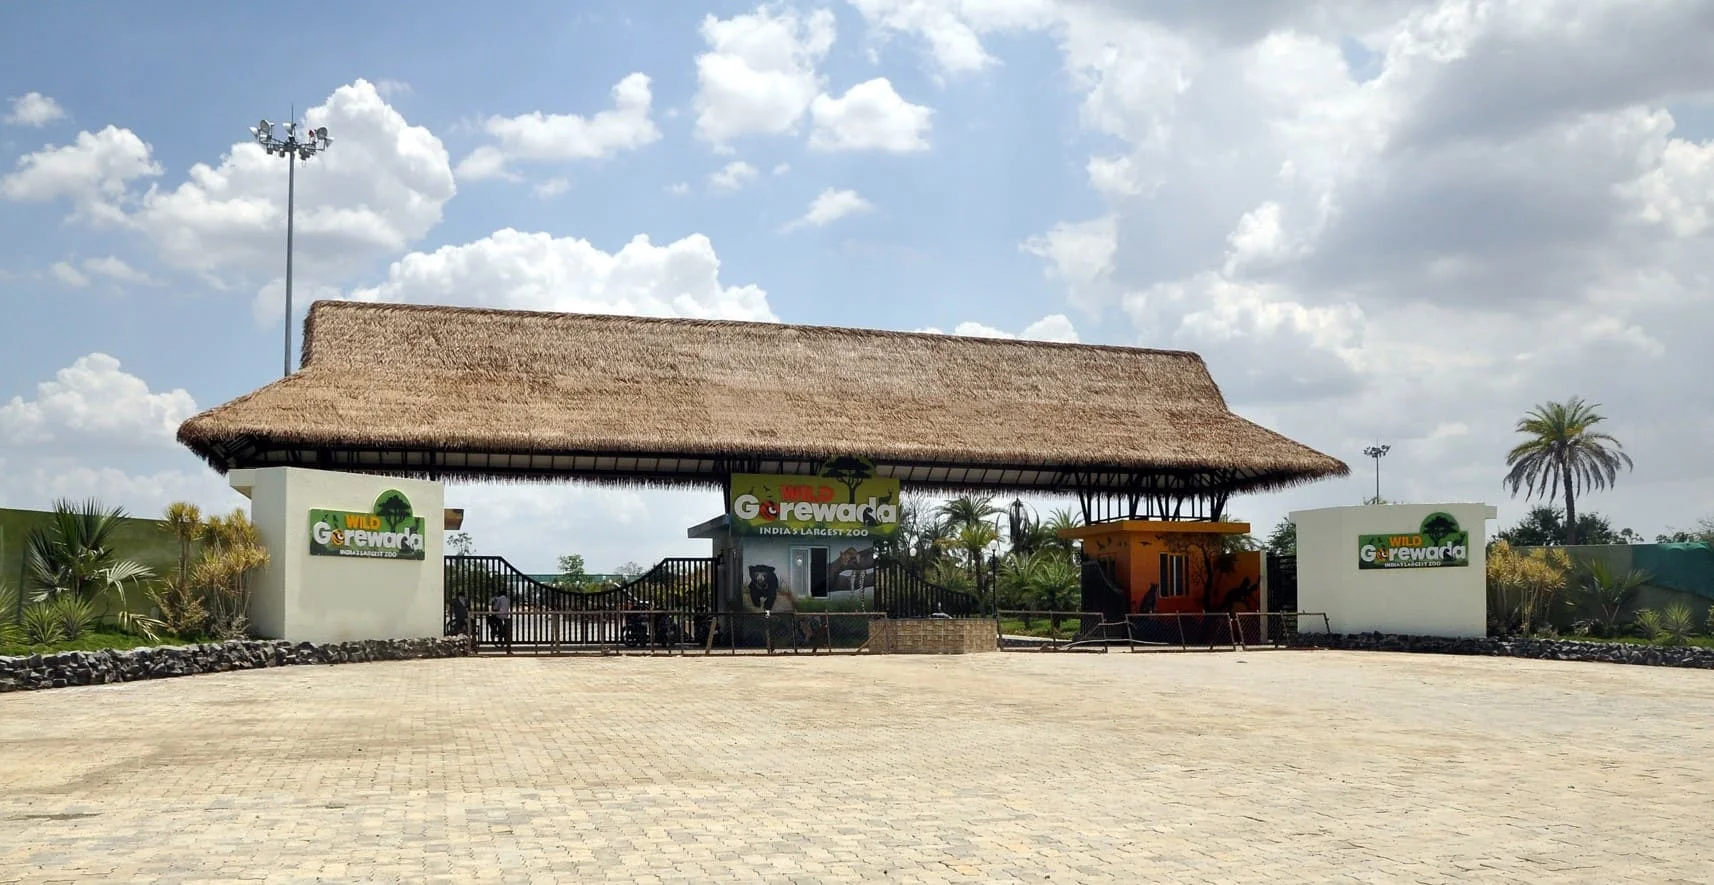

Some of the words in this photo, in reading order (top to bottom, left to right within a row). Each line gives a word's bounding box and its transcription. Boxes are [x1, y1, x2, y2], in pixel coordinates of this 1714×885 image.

[781, 484, 834, 503] WILD
[734, 495, 897, 523] Gorewada
[345, 514, 381, 529] WILD
[313, 521, 424, 551] Gorewada
[759, 527, 798, 535] INDIA'S
[801, 527, 842, 536] LARGEST
[846, 528, 869, 537] ZOO
[1389, 535, 1422, 547] WILD
[1360, 541, 1467, 562] Gorewada
